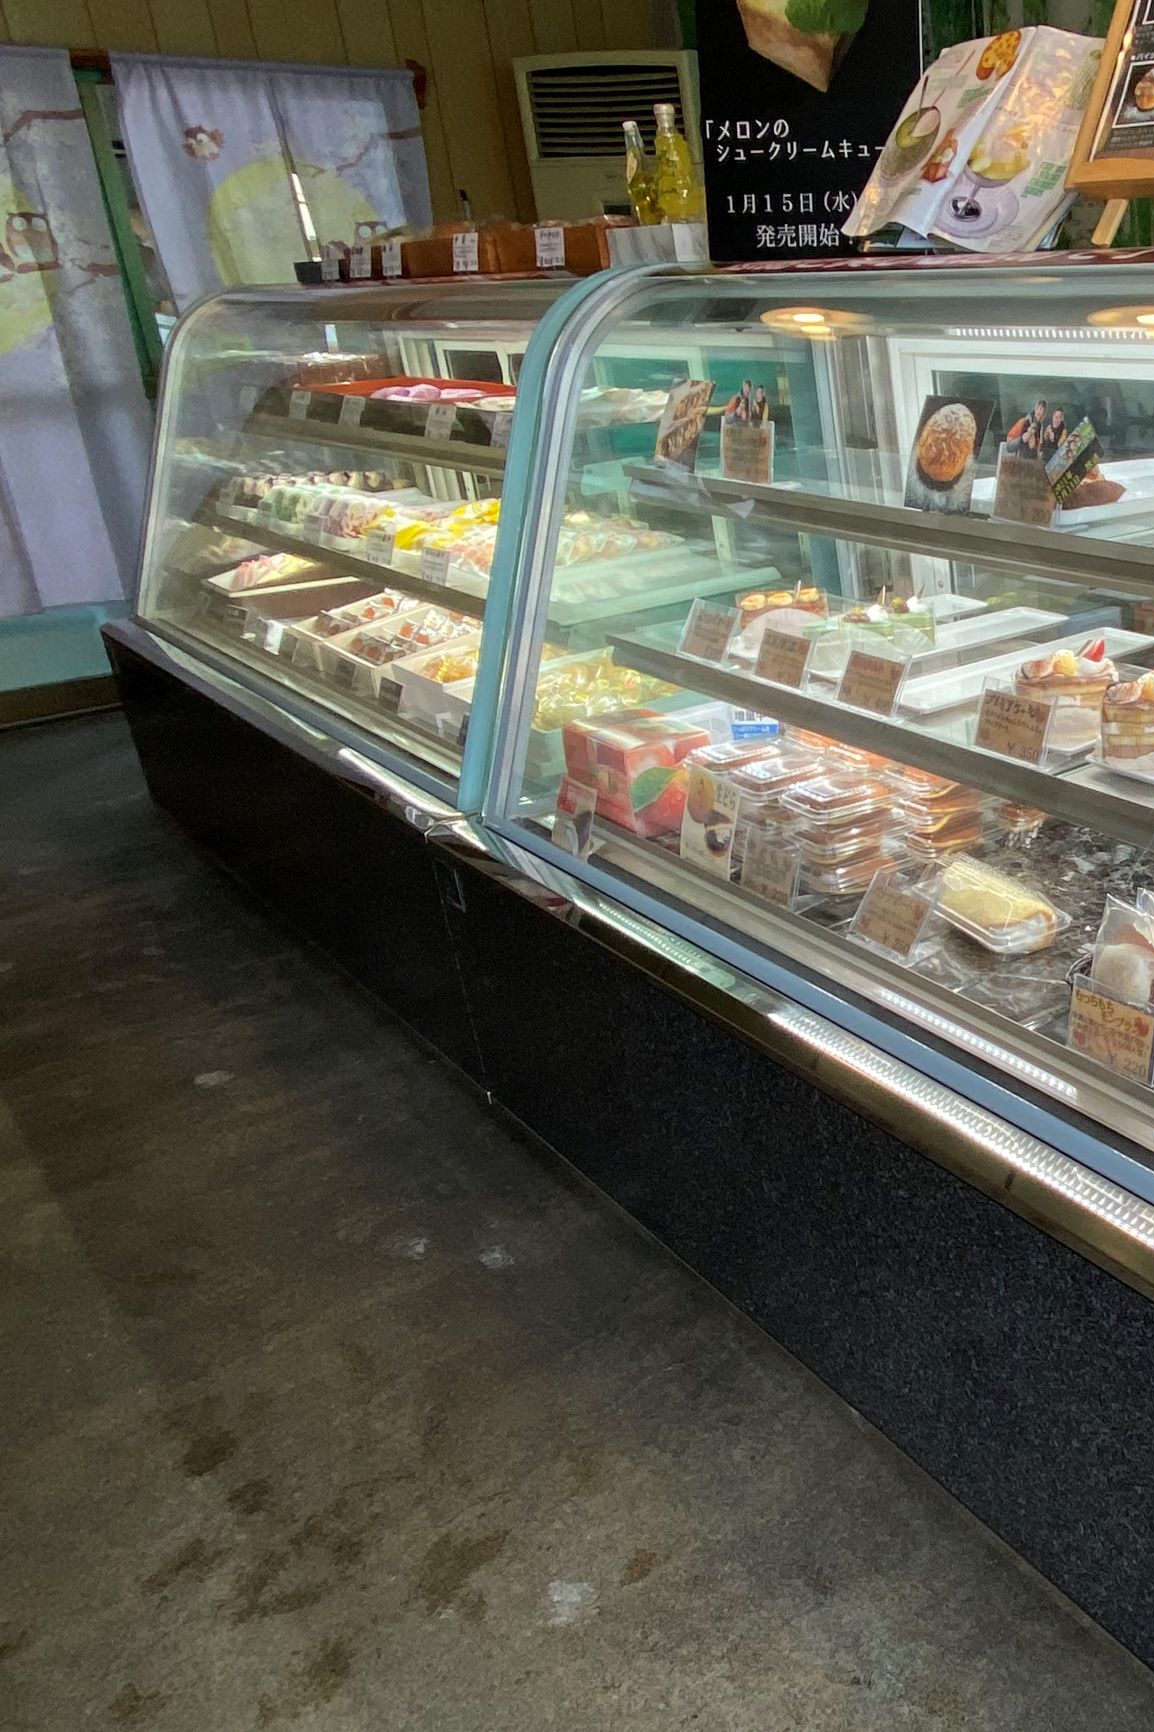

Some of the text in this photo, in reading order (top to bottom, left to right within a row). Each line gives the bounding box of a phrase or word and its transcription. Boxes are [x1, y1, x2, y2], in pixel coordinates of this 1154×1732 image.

[706, 119, 790, 140] 「メロンの
[756, 223, 854, 248] 発売開始
[1123, 1057, 1147, 1077] 220
